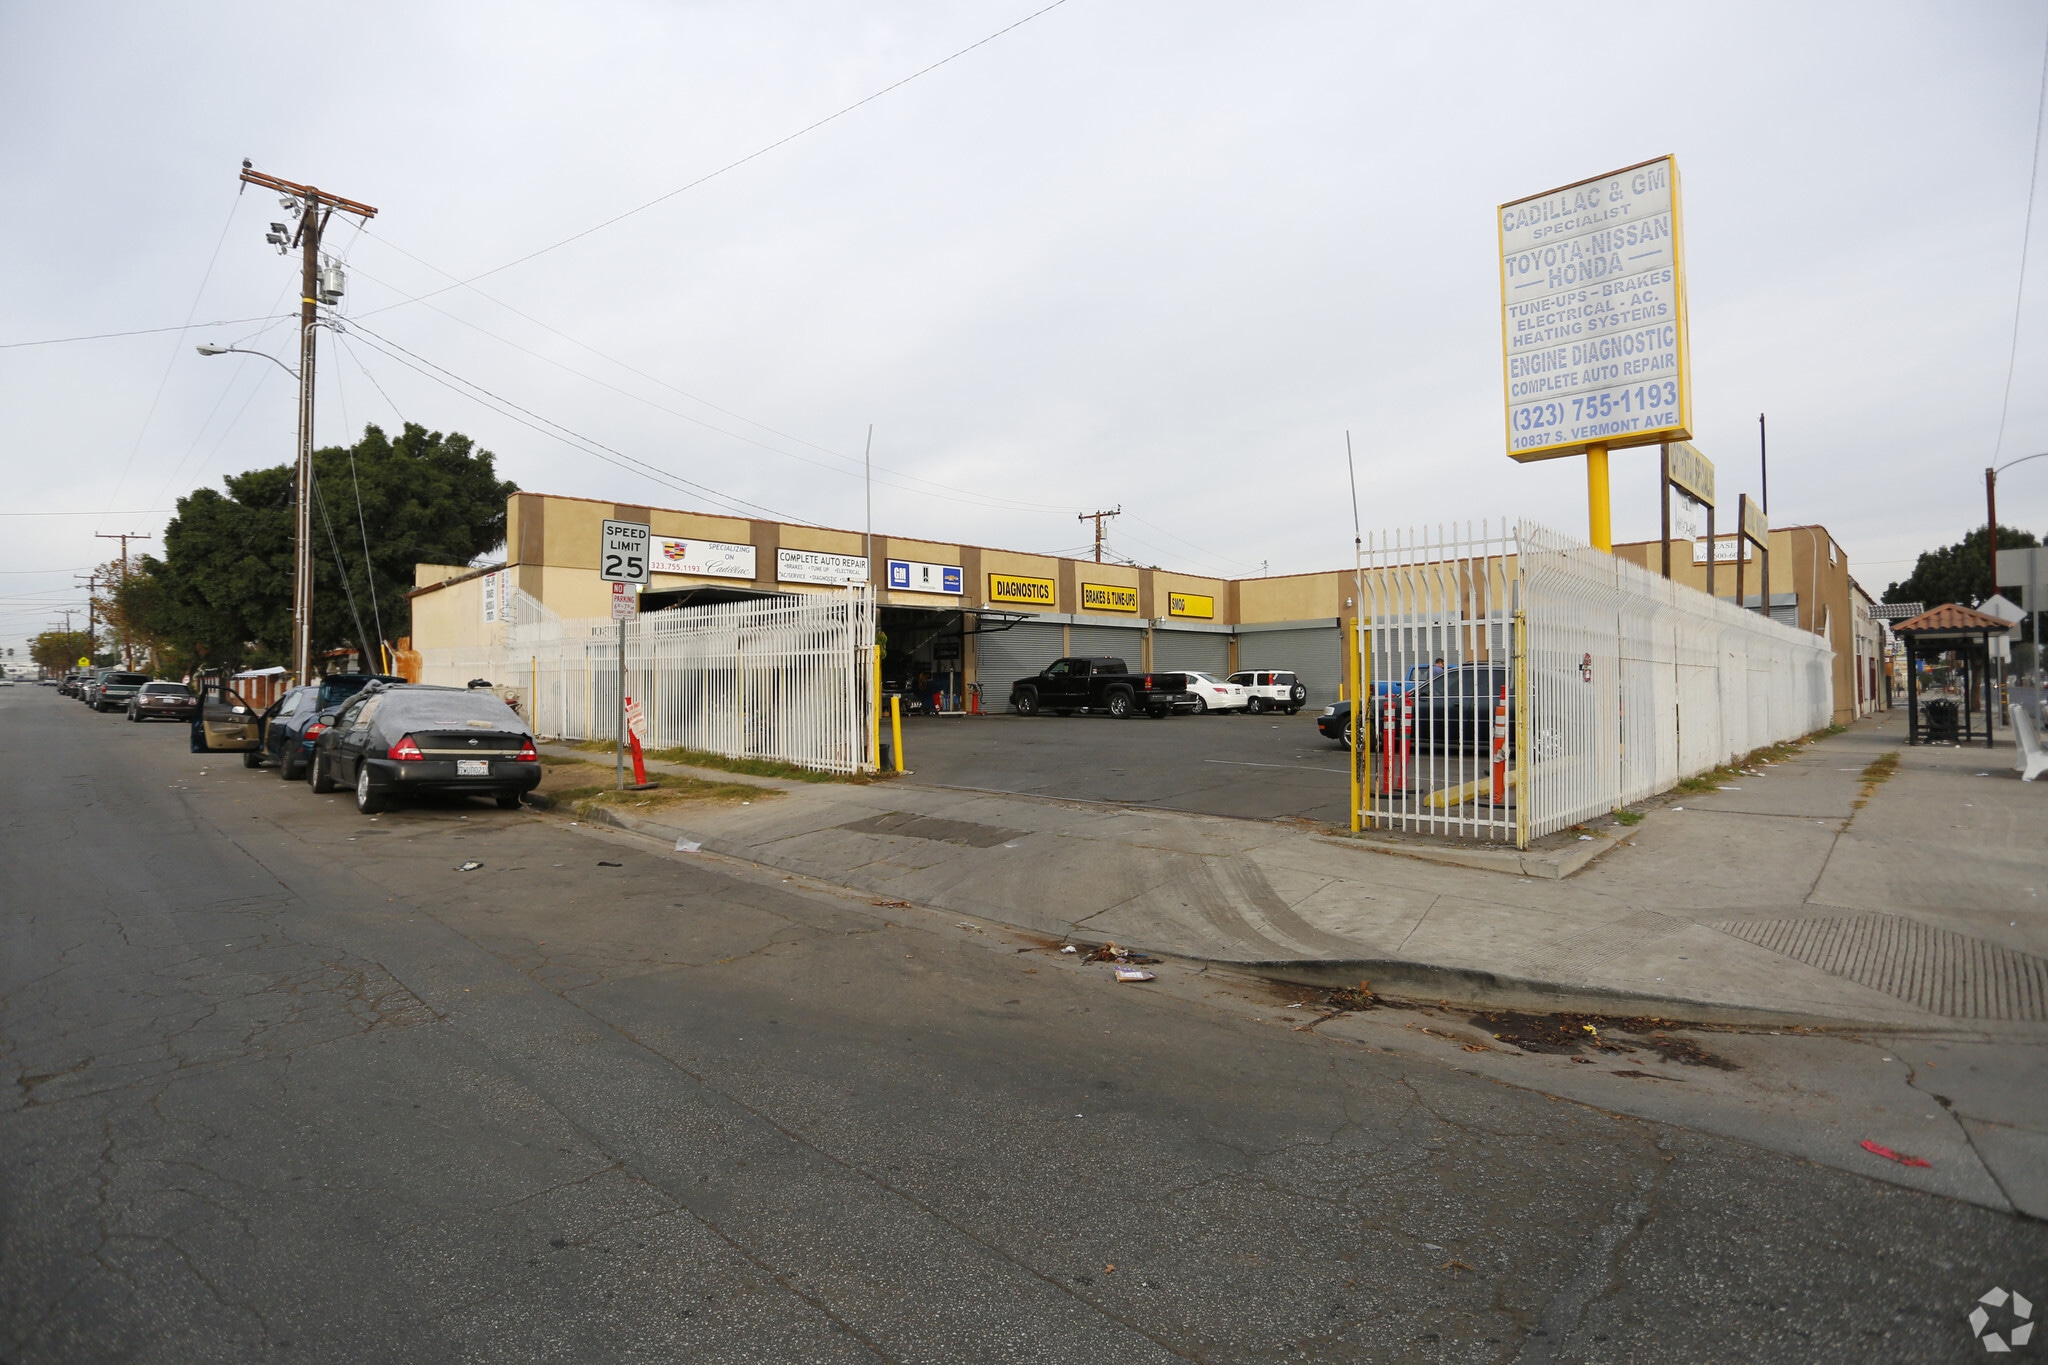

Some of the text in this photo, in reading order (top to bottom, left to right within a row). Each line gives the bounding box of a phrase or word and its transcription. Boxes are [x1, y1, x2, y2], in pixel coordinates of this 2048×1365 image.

[1503, 168, 1665, 232] CADILLAC & GM
[1533, 203, 1631, 239] SPECIALIST
[1548, 252, 1624, 289] HONDA
[1509, 290, 1587, 318] TUNE-UPS
[1602, 270, 1672, 297] BRAKES
[1517, 300, 1615, 331] ELECTRICAL
[1630, 290, 1659, 306] AC.
[1512, 303, 1668, 347] HEATING SYSTEMS
[1510, 326, 1674, 378] ENGINE DIAGNOSTIC
[1512, 353, 1675, 397] COMPLETE AUTO REPAIR
[1513, 381, 1677, 431] (323) 755-1193
[1514, 411, 1678, 448] 10837 S. VERMONT AVE.
[606, 525, 647, 539] SPEED
[610, 540, 641, 552] LIMIT
[708, 543, 750, 554] SPECIALIZING
[1713, 542, 1737, 550] EASE
[605, 554, 643, 579] 25
[651, 561, 700, 573] 323.755.1193
[705, 560, 751, 575] Cadillac
[779, 552, 866, 569] COMPLETE AUTO REPAIR
[893, 566, 907, 580] GM
[613, 584, 623, 593] NO
[996, 580, 1050, 599] DIAGNOSTICS
[1085, 589, 1106, 605] BRAKES
[1111, 591, 1136, 607] TUNE-UPS
[613, 595, 635, 603] PARKING
